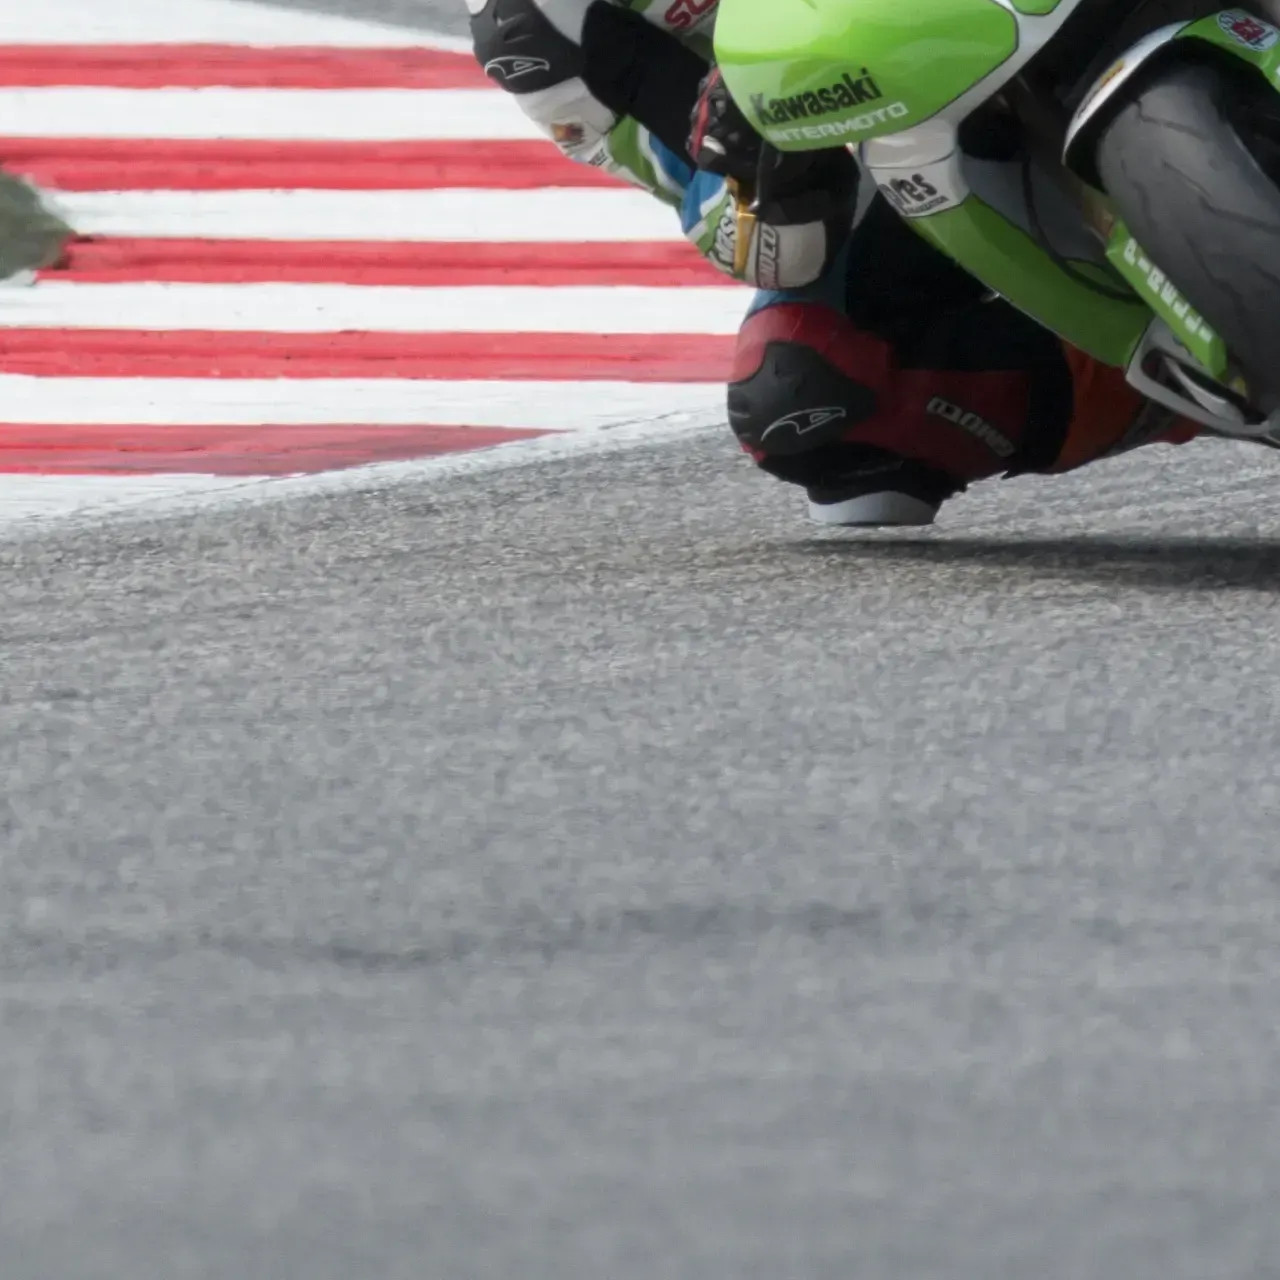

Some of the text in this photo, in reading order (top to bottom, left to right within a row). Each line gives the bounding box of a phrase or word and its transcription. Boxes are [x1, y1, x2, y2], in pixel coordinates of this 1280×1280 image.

[749, 66, 884, 126] Kawasaki
[764, 100, 910, 142] INTERMOTO
[1123, 236, 1214, 344] PIRELLI
